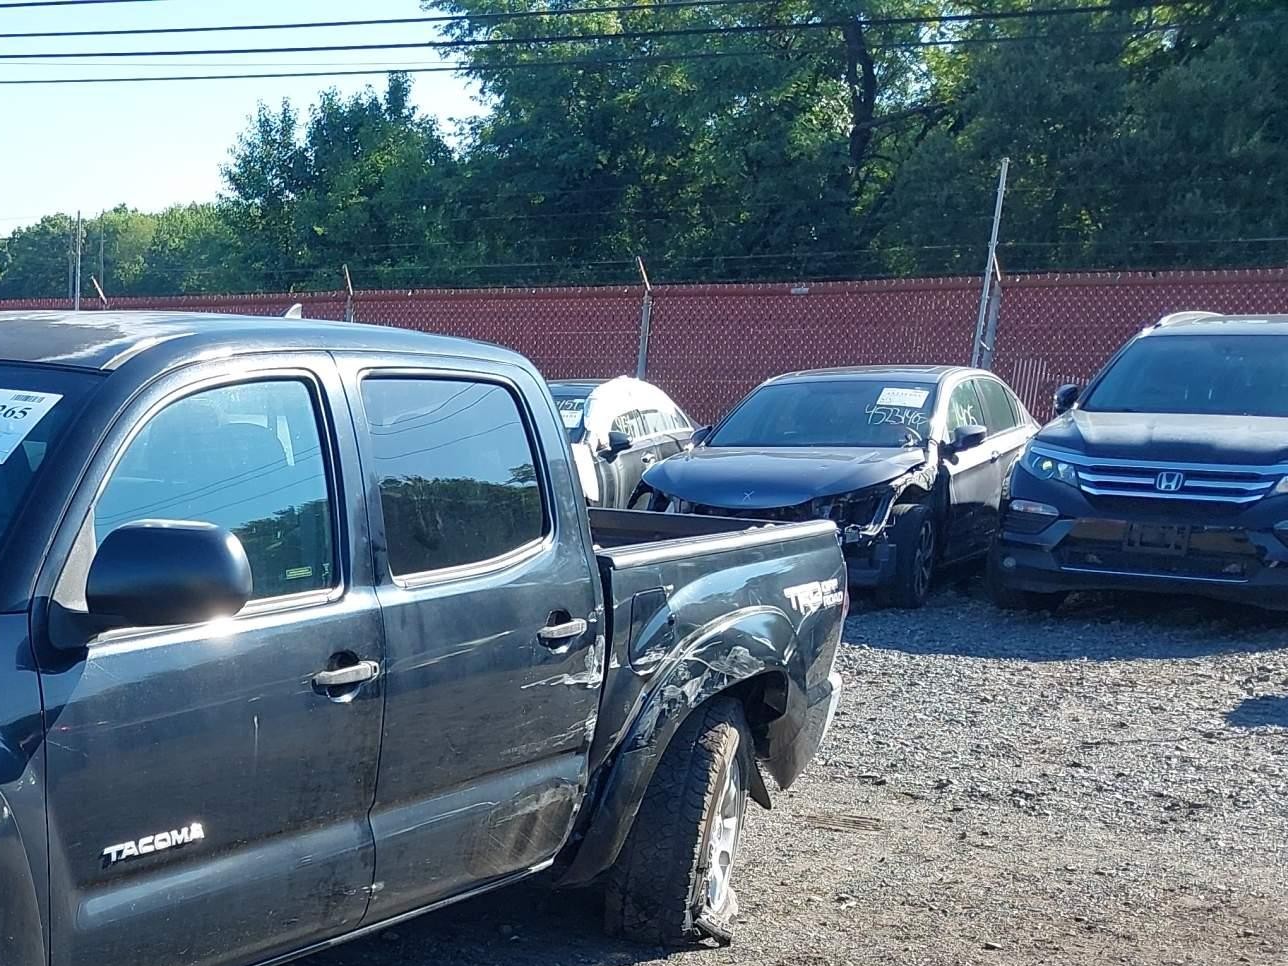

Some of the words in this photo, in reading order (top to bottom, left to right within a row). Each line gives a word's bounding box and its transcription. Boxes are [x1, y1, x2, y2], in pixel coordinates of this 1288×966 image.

[784, 581, 823, 616] TRD
[822, 591, 843, 609] ROAD
[102, 823, 205, 863] TACOMA
